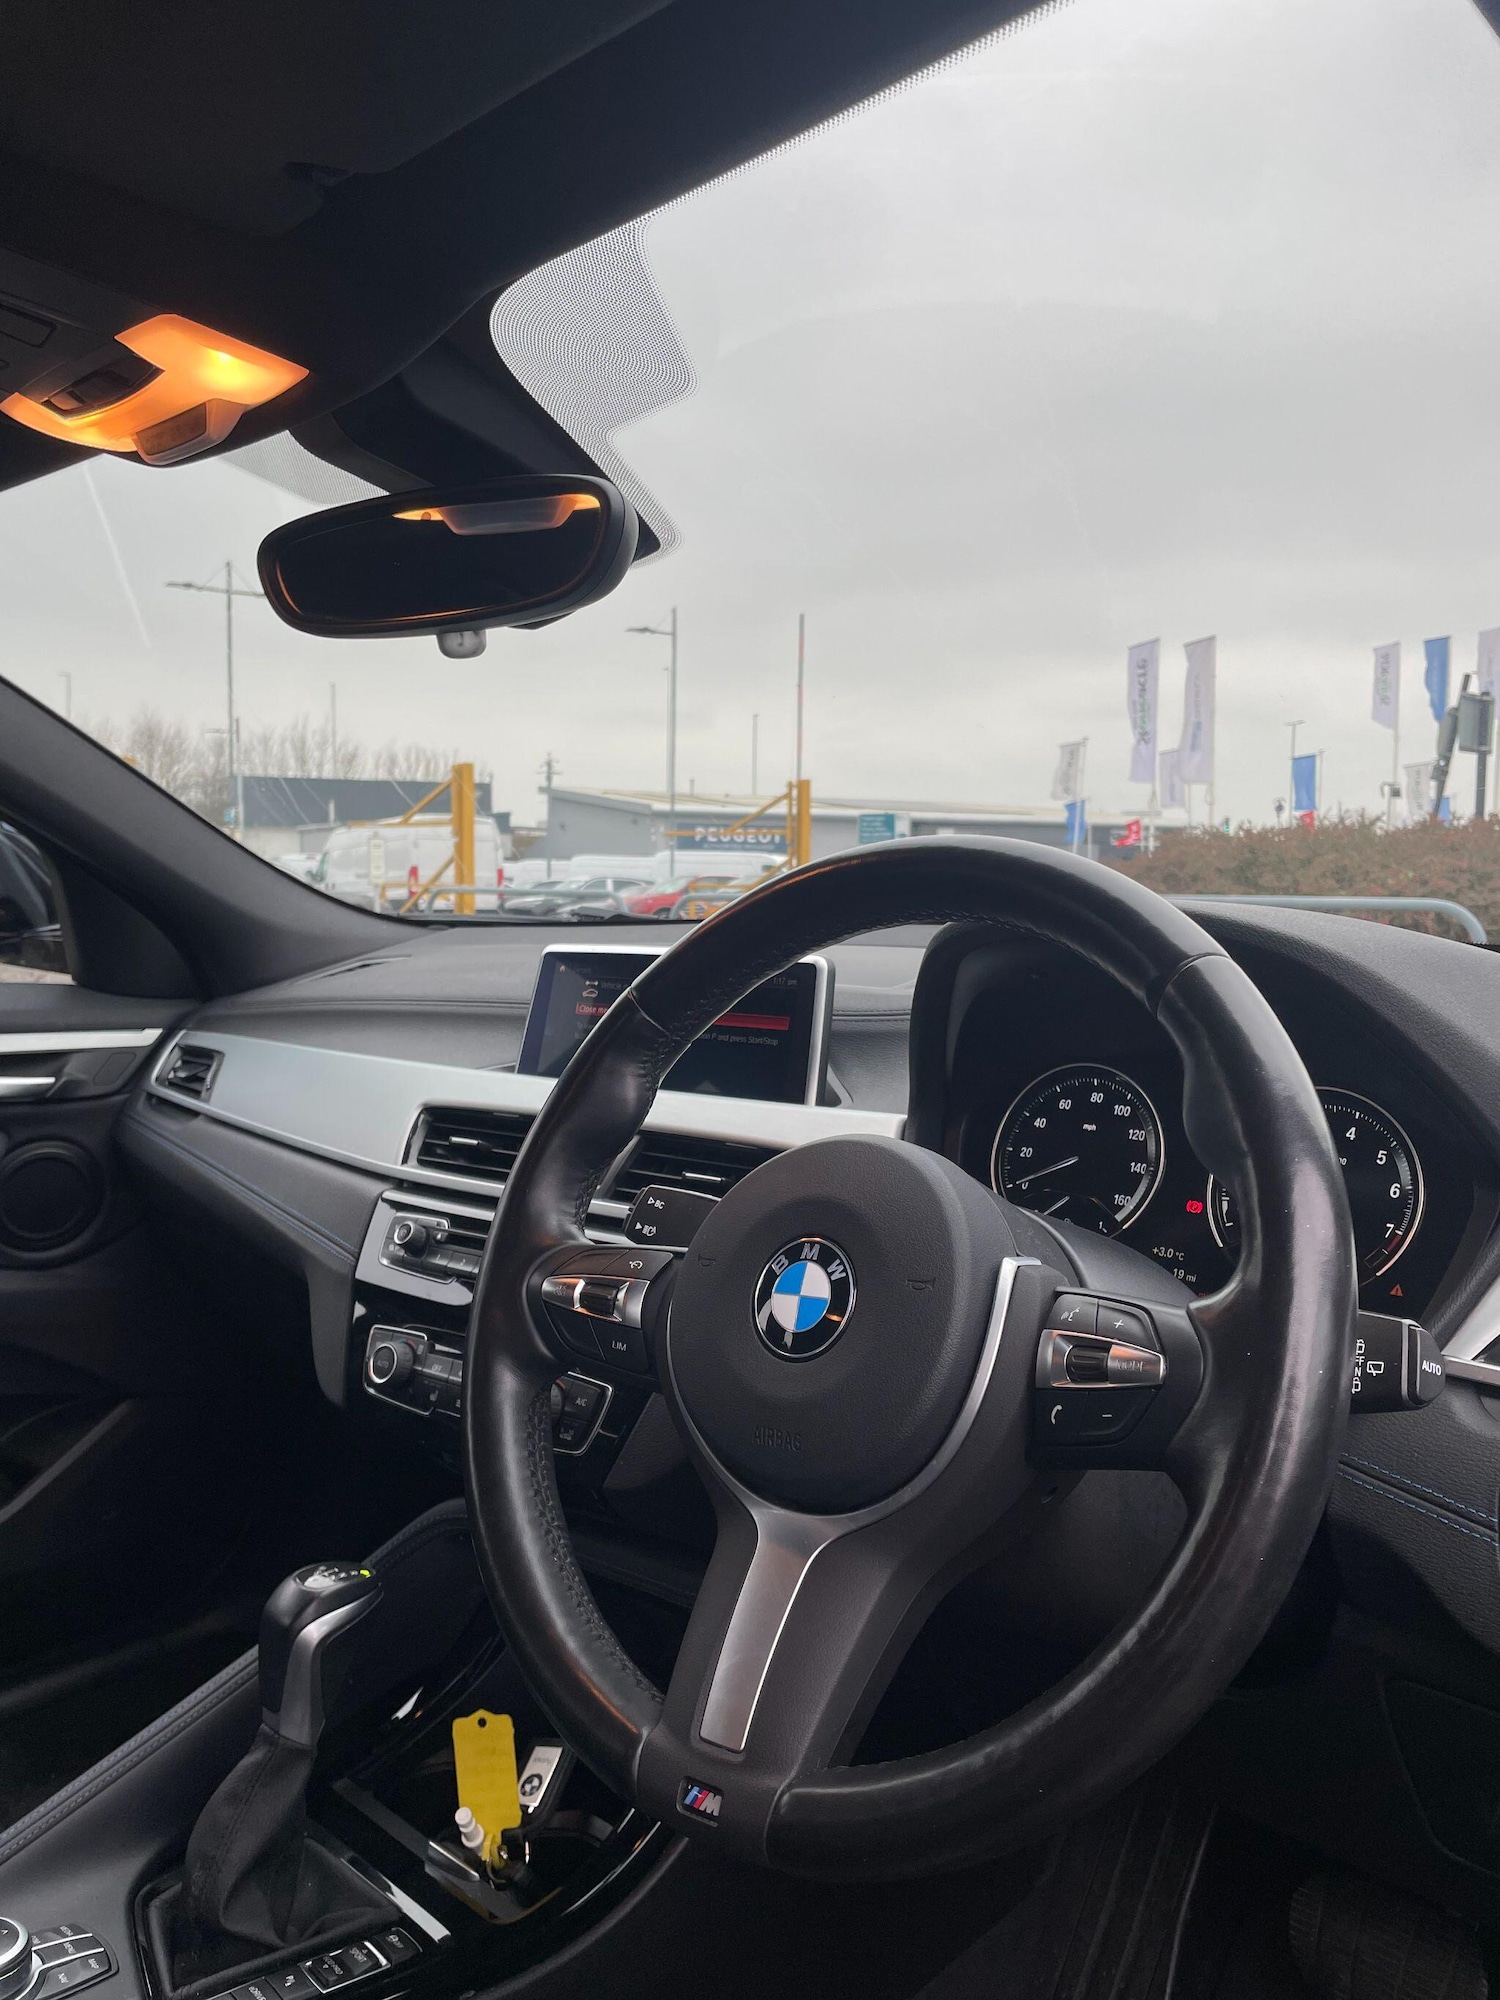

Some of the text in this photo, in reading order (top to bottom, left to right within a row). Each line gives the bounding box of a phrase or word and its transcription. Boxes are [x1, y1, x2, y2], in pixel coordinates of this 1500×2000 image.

[694, 826, 781, 844] PEUGEOT
[580, 1004, 597, 1014] Close
[717, 1034, 728, 1042] and
[730, 1035, 747, 1044] press
[748, 1035, 779, 1046] Start/Stop
[1090, 1092, 1104, 1103] 80
[1058, 1099, 1072, 1110] 60
[1113, 1104, 1131, 1117] 100
[1033, 1117, 1047, 1129] 40
[1082, 1123, 1097, 1132] mph
[1128, 1128, 1146, 1141] 120
[1345, 1126, 1357, 1141] 4
[1020, 1147, 1033, 1158] 20
[1376, 1150, 1388, 1165] 5
[1130, 1162, 1147, 1174] 140
[1389, 1182, 1401, 1199] 6
[654, 1199, 666, 1210] BC
[1113, 1194, 1132, 1206] 160
[1384, 1223, 1395, 1239] 7
[1152, 1246, 1174, 1259] +3.0
[771, 1243, 846, 1281] BMW
[1172, 1267, 1197, 1283] 19 mi
[611, 1339, 628, 1352] LIM
[1421, 1359, 1442, 1376] AUTO
[753, 1425, 801, 1451] AIRBAG
[350, 1947, 367, 1963] SPORT
